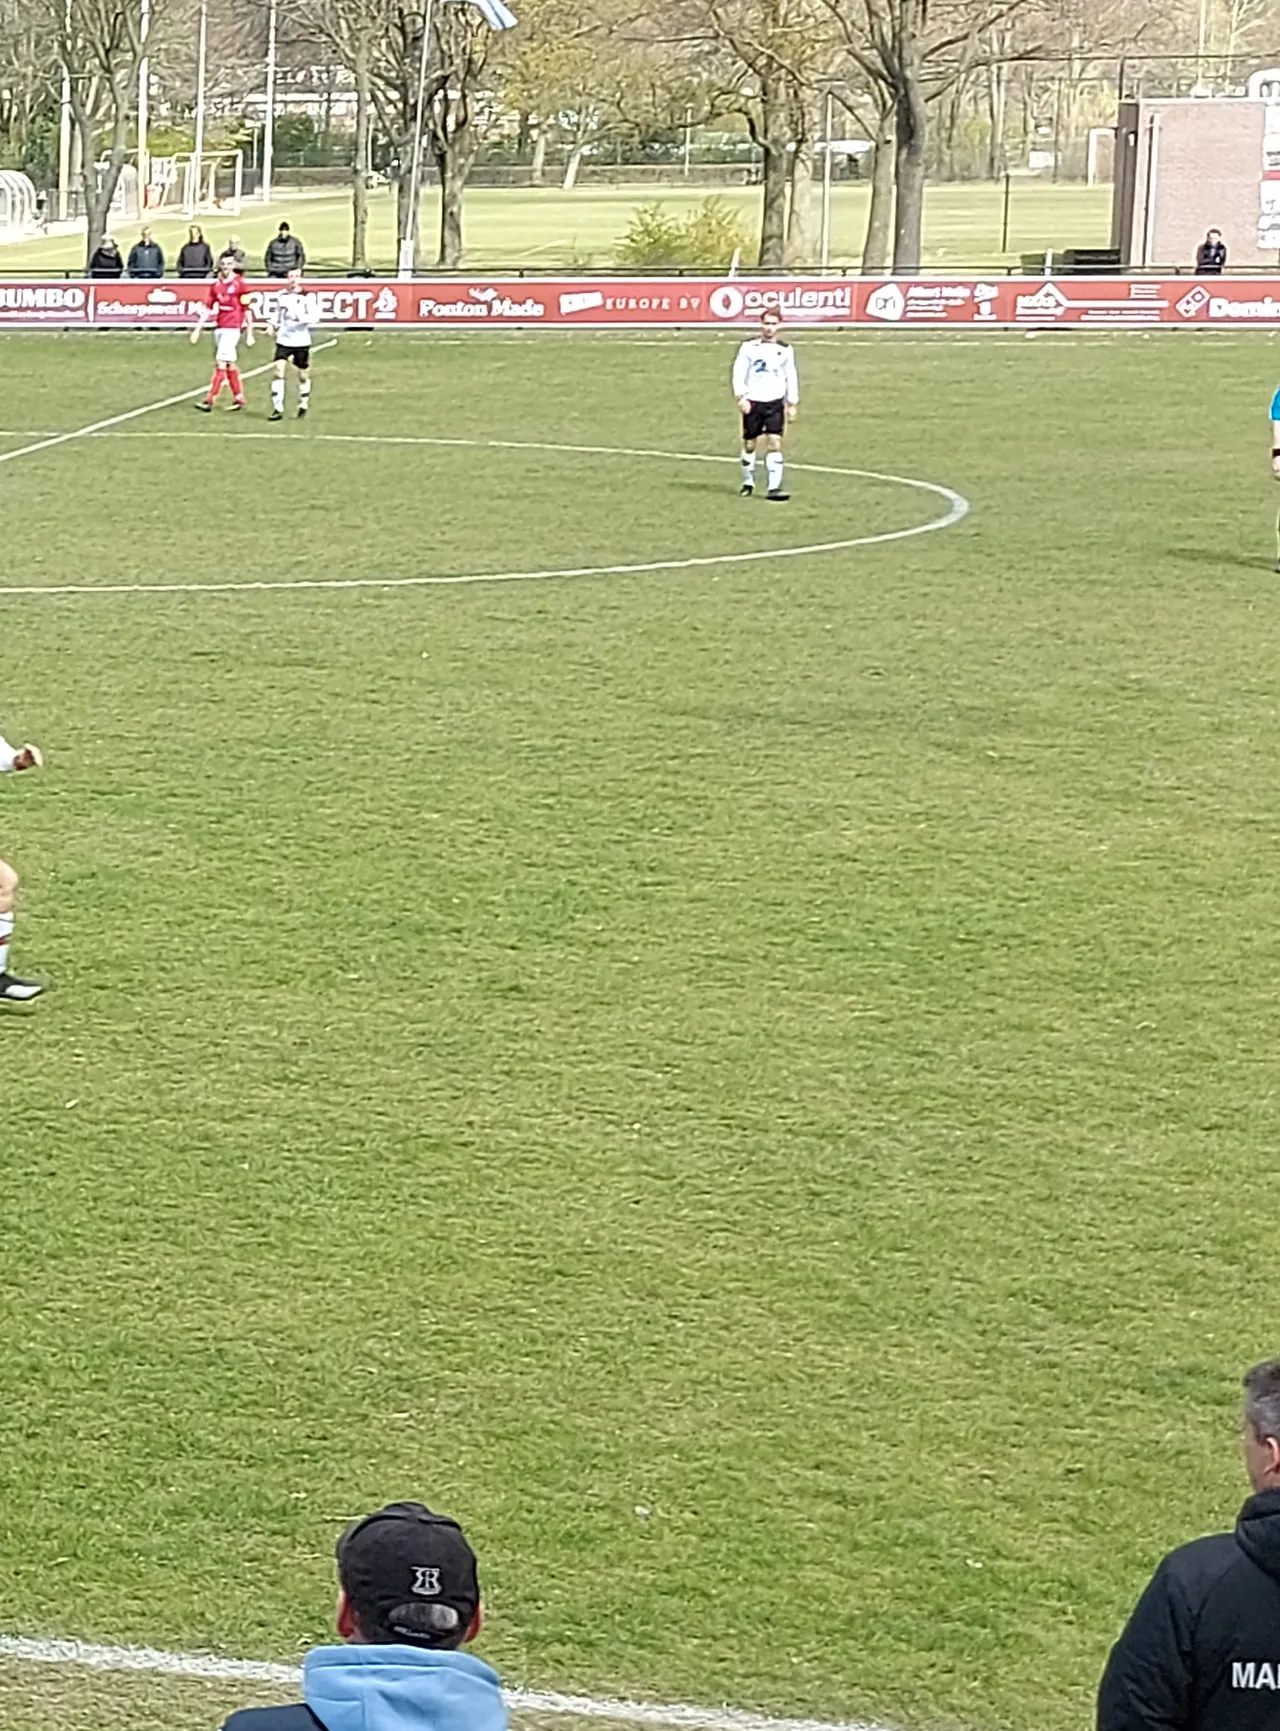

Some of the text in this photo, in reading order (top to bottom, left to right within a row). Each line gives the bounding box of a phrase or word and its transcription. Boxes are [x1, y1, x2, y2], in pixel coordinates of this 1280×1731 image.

[247, 290, 374, 320] REECT
[490, 297, 545, 317] Made
[604, 297, 671, 311] EUROPE
[1231, 1661, 1280, 1691] MA
